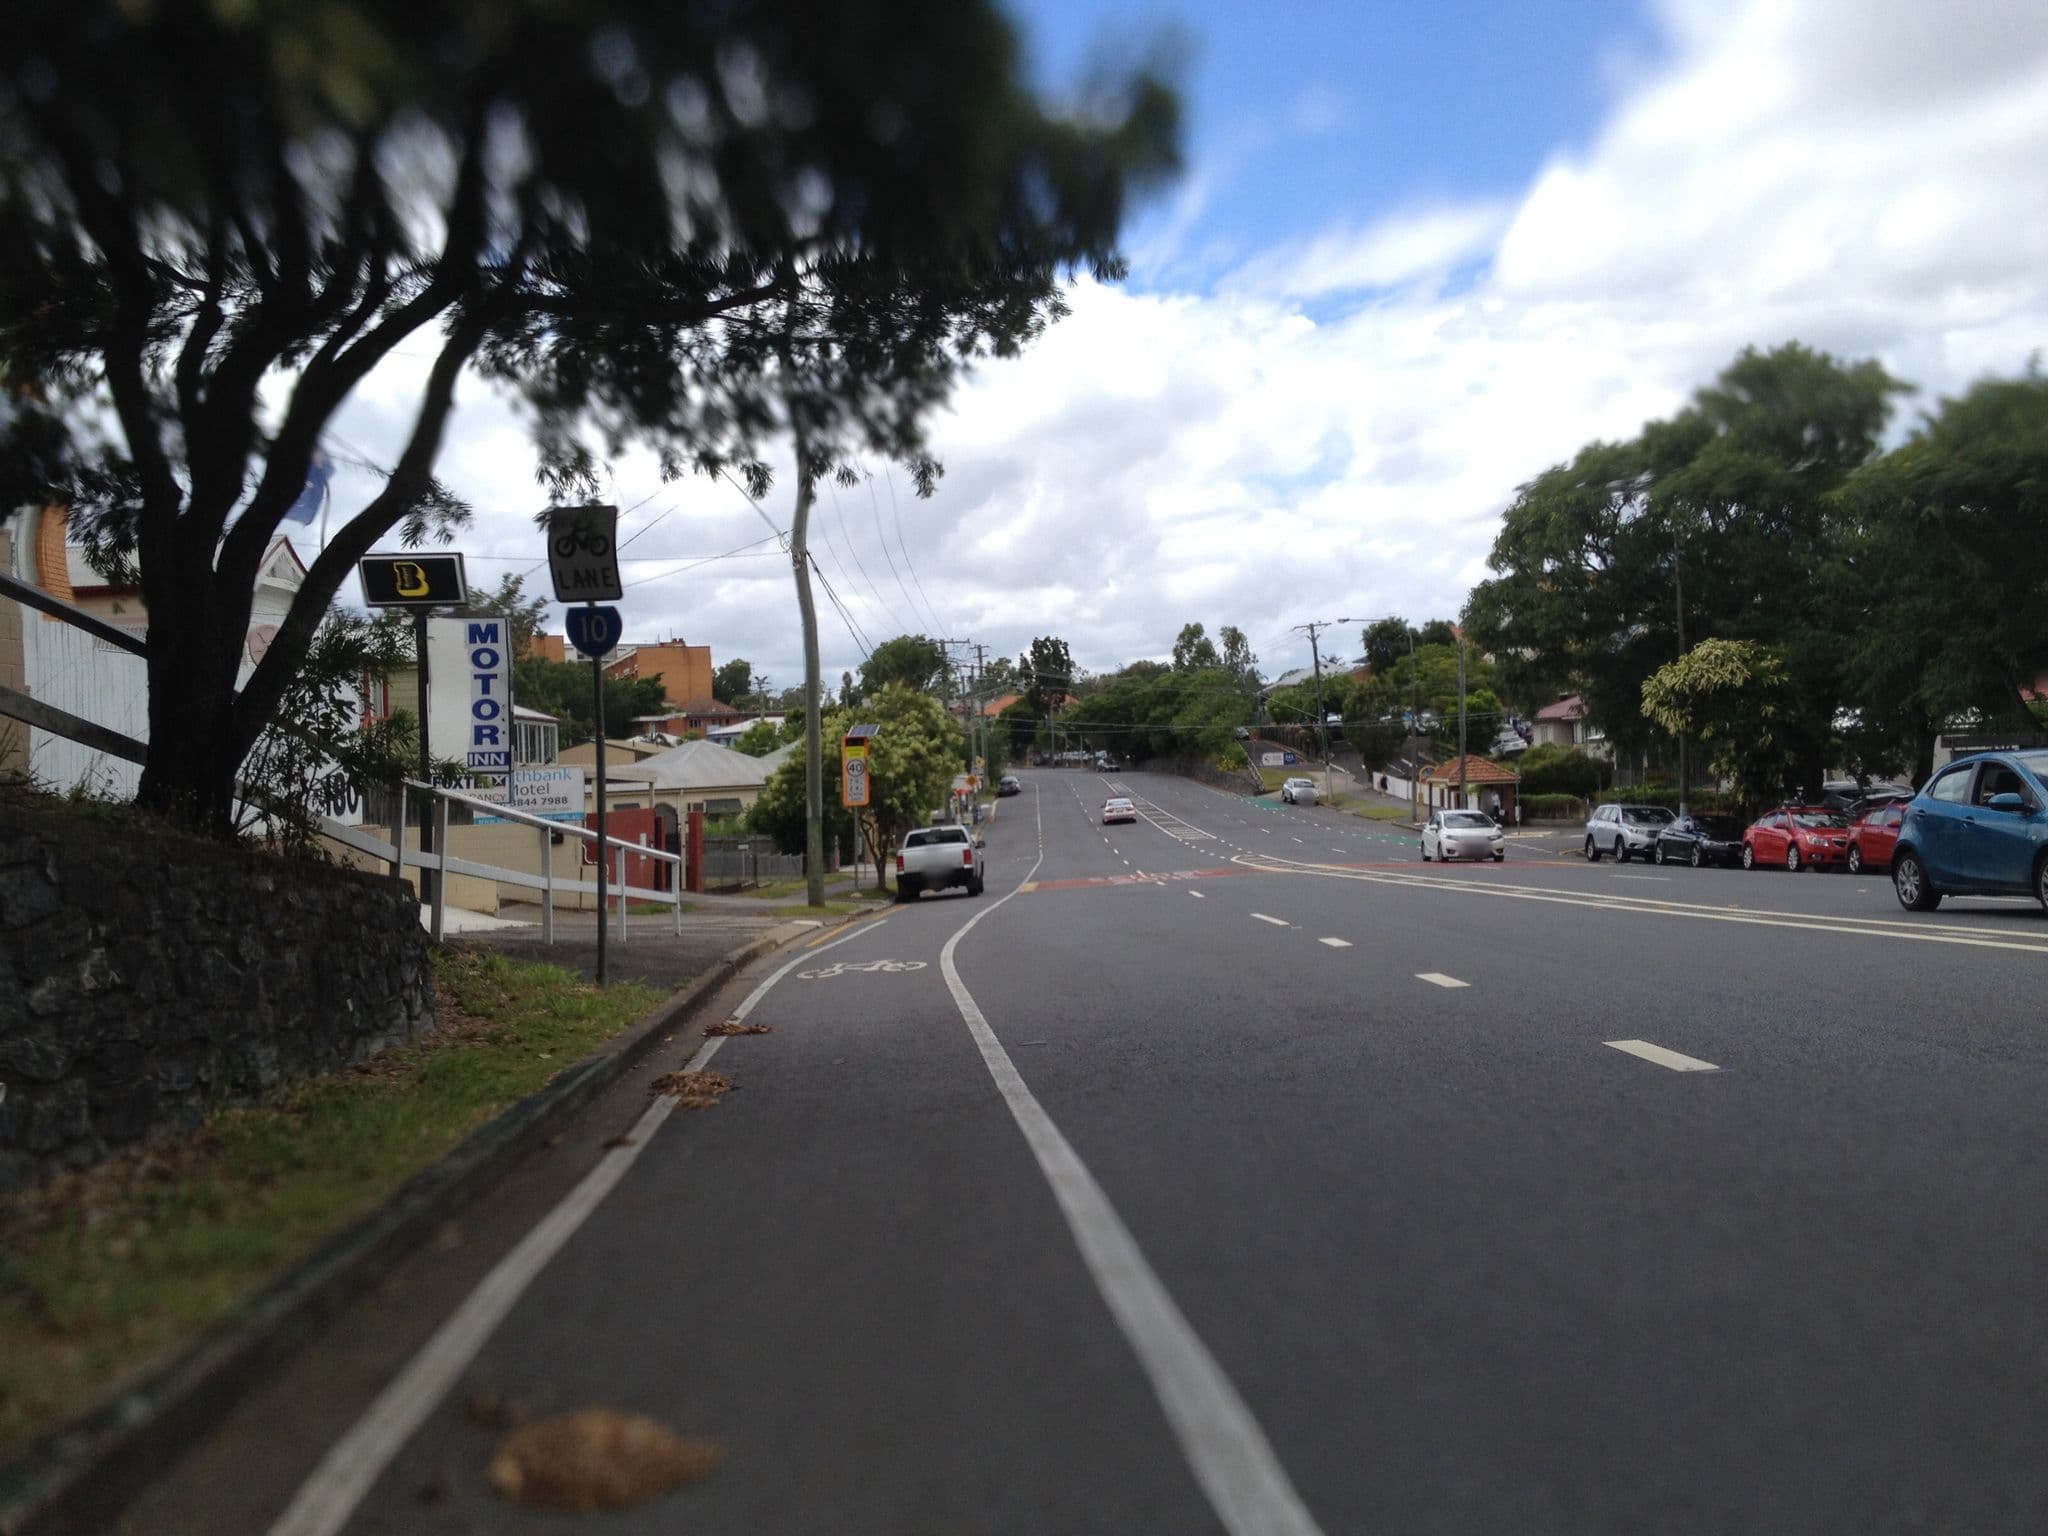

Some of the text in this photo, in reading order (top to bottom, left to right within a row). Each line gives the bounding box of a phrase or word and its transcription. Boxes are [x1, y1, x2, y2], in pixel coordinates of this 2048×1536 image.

[557, 567, 615, 590] LANE
[580, 614, 609, 643] 10
[468, 623, 501, 746] MOTOR
[468, 752, 506, 766] INN
[849, 763, 862, 772] 40
[514, 768, 572, 783] thbank
[541, 796, 569, 805] 7988
